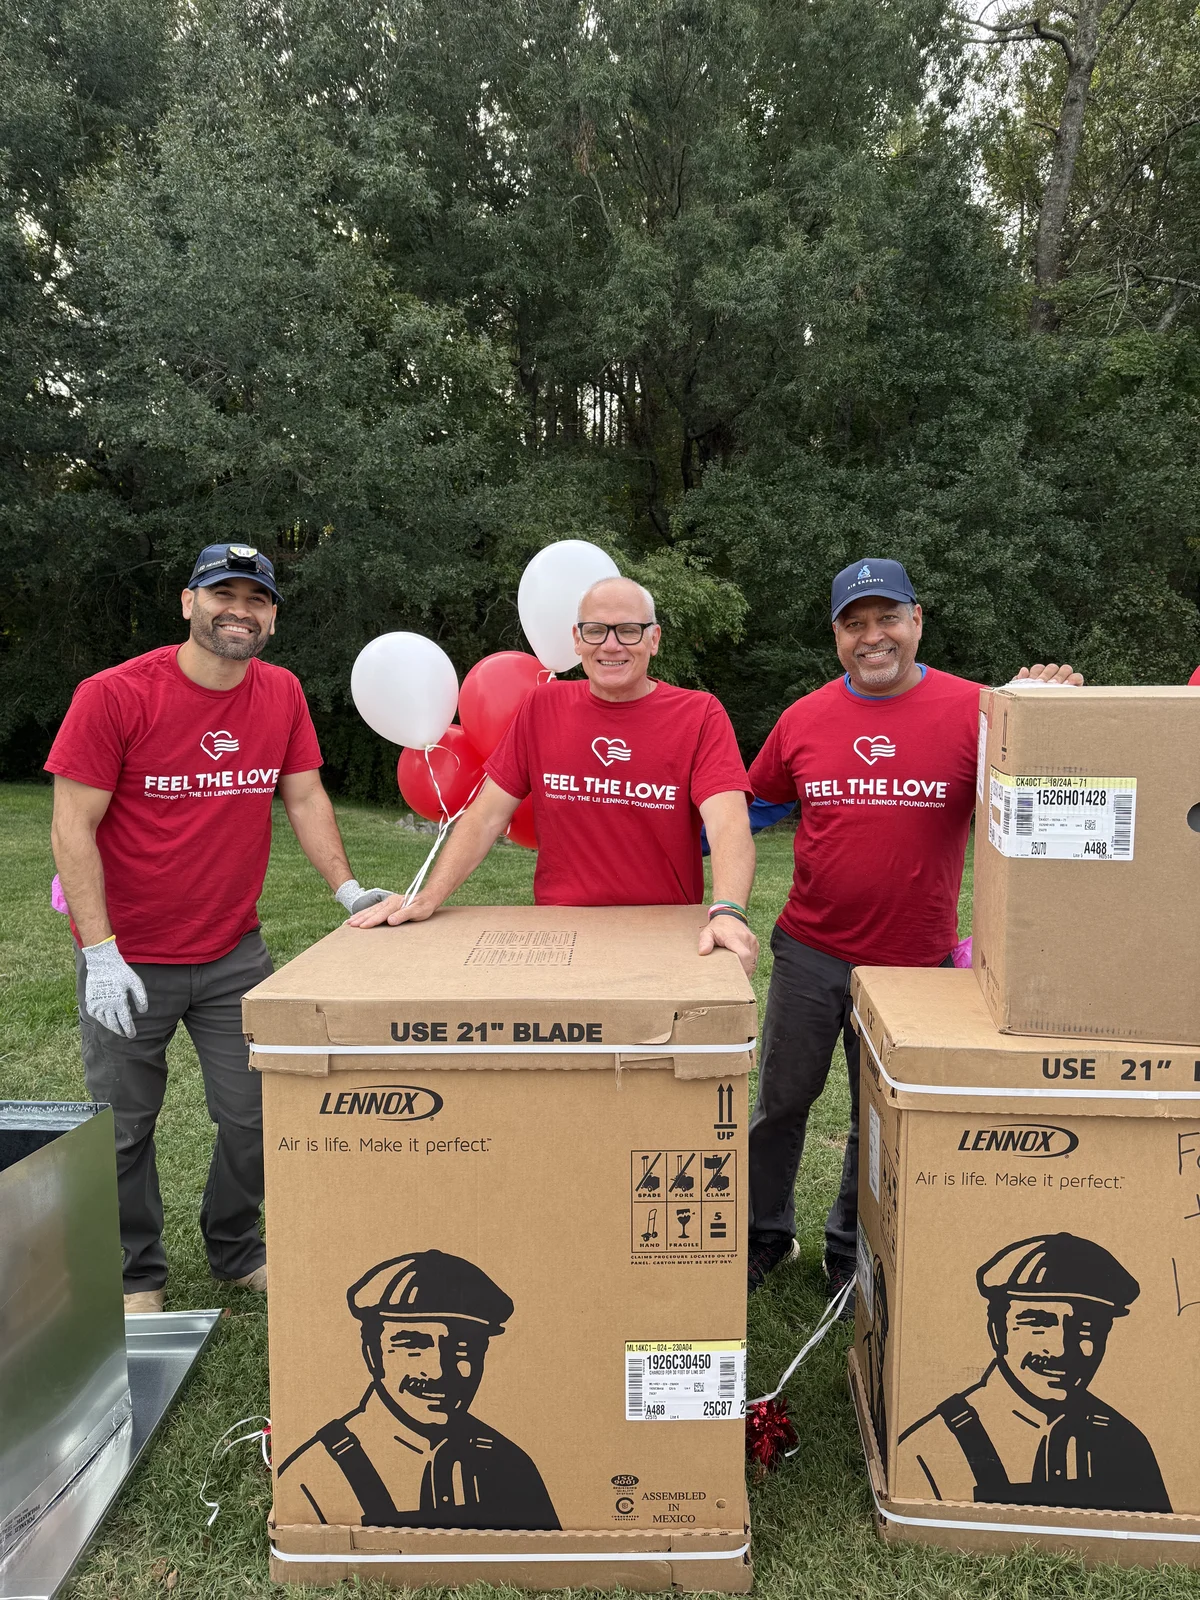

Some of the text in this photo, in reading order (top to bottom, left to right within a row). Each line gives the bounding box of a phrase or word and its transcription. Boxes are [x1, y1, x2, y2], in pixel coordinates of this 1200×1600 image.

[144, 768, 280, 791] FEEL THE LOVE
[543, 773, 677, 801] FEEL THE LOVE
[213, 788, 241, 797] LENNOX
[804, 778, 947, 799] FEEL THE LOVE
[602, 797, 630, 806] LENNOX
[631, 801, 675, 810] FOUNDATION
[899, 800, 946, 809] FOUNDATION
[1036, 789, 1107, 806] 1526H01428
[1083, 841, 1107, 855] A488
[391, 1022, 603, 1043] USE 21" BLADE
[1042, 1058, 1096, 1080] USE
[319, 1092, 419, 1115] LENNOX
[717, 1131, 735, 1140] UP
[957, 1130, 1056, 1152] LENNOX
[278, 1137, 300, 1152] Air
[306, 1137, 318, 1152] is
[324, 1137, 351, 1152] life.
[359, 1138, 402, 1152] Make
[409, 1137, 419, 1152] it
[915, 1171, 938, 1186] Air
[944, 1171, 956, 1186] is
[961, 1172, 987, 1186] life.
[995, 1172, 1037, 1187] Make
[1043, 1172, 1053, 1188] it
[714, 1212, 722, 1220] 5
[646, 1354, 711, 1370] 1926C30450
[646, 1405, 666, 1416] A488
[703, 1401, 733, 1416] 25C87
[642, 1492, 706, 1501] ASSEMBLED
[653, 1515, 696, 1523] MEXICO
